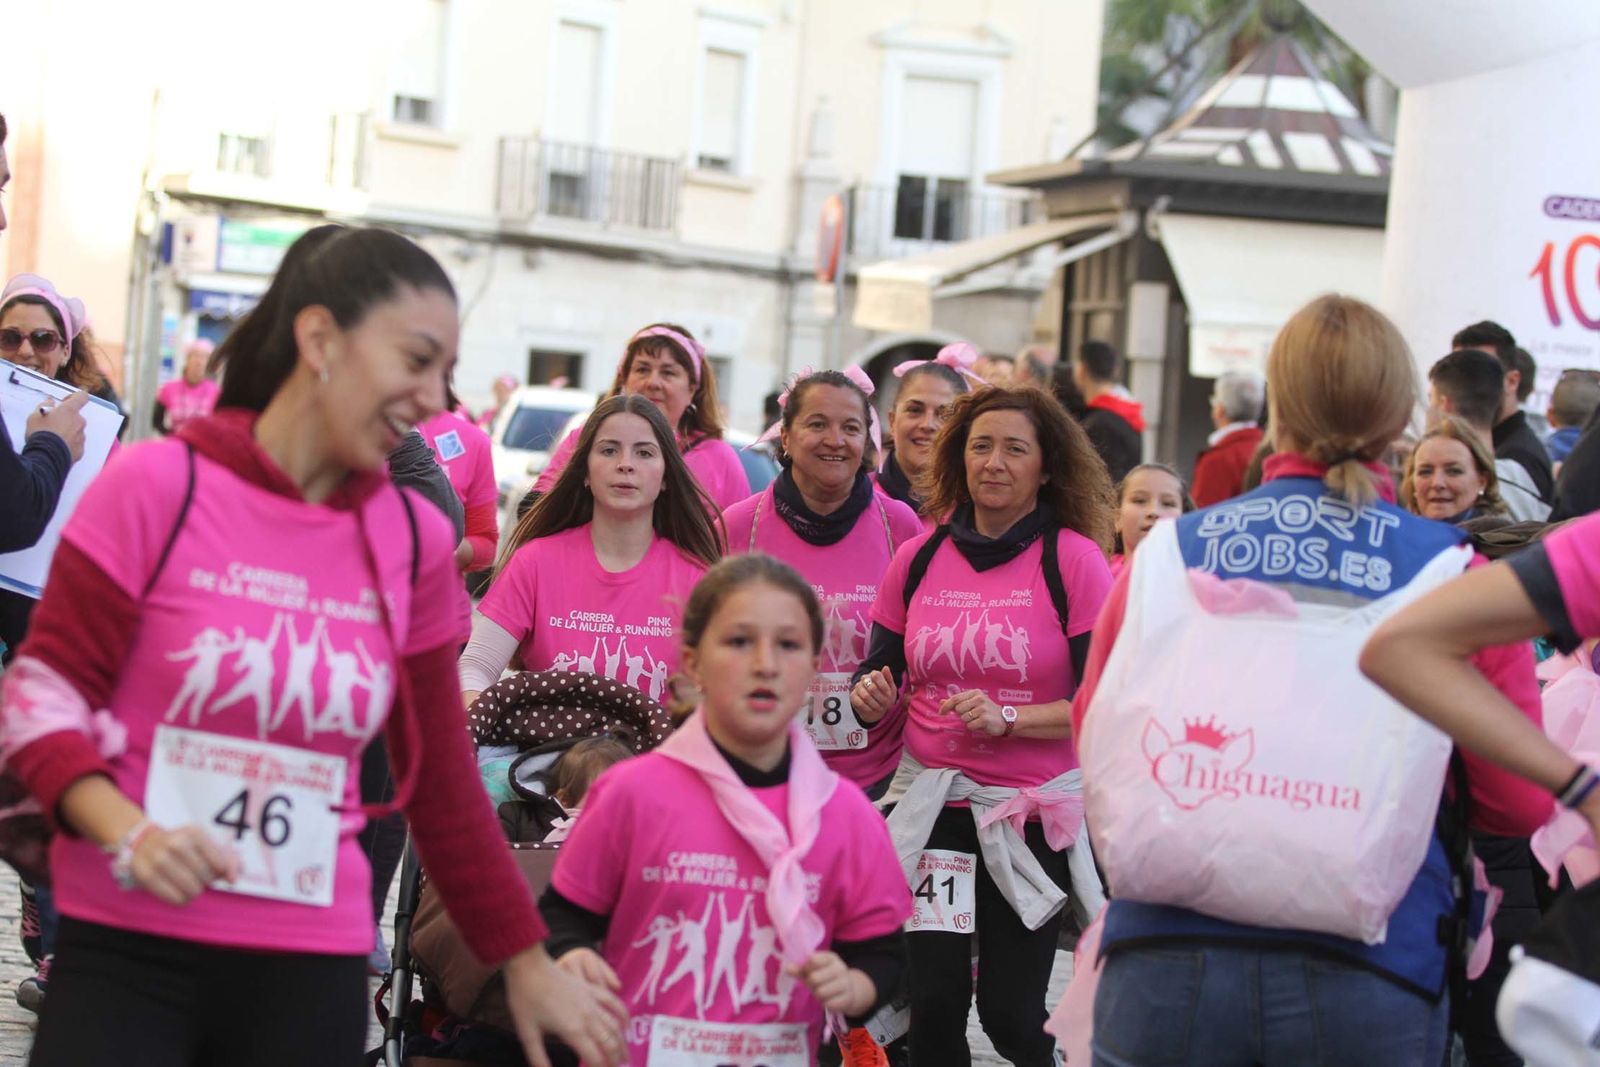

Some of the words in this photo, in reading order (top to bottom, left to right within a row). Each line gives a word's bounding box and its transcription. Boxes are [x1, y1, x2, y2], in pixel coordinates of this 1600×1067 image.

[1197, 494, 1400, 548] SPORT
[1201, 532, 1393, 592] JOBS.ES
[835, 592, 878, 603] RUNNING
[855, 584, 877, 594] PINK
[940, 589, 982, 601] CARRERA
[1010, 588, 1033, 599] PINK
[921, 595, 933, 606] DE
[933, 598, 945, 607] LA
[946, 599, 980, 609] MUJER
[988, 598, 1033, 608] RUNNING
[569, 609, 615, 624] CARRERA
[647, 616, 672, 627] PINK
[549, 616, 563, 628] DE
[564, 619, 577, 630] LA
[579, 621, 615, 634] MUJER
[615, 626, 622, 634] &
[624, 624, 673, 638] RUNNING
[807, 696, 842, 726] 18
[1151, 750, 1363, 812] Chiguagua
[213, 788, 294, 848] 46
[667, 851, 738, 871] CARRERA
[934, 862, 973, 874] RUNNING
[953, 856, 972, 866] PINK
[642, 866, 660, 882] DE
[663, 867, 681, 883] LA
[683, 868, 737, 888] MUJER
[914, 873, 955, 906] 41
